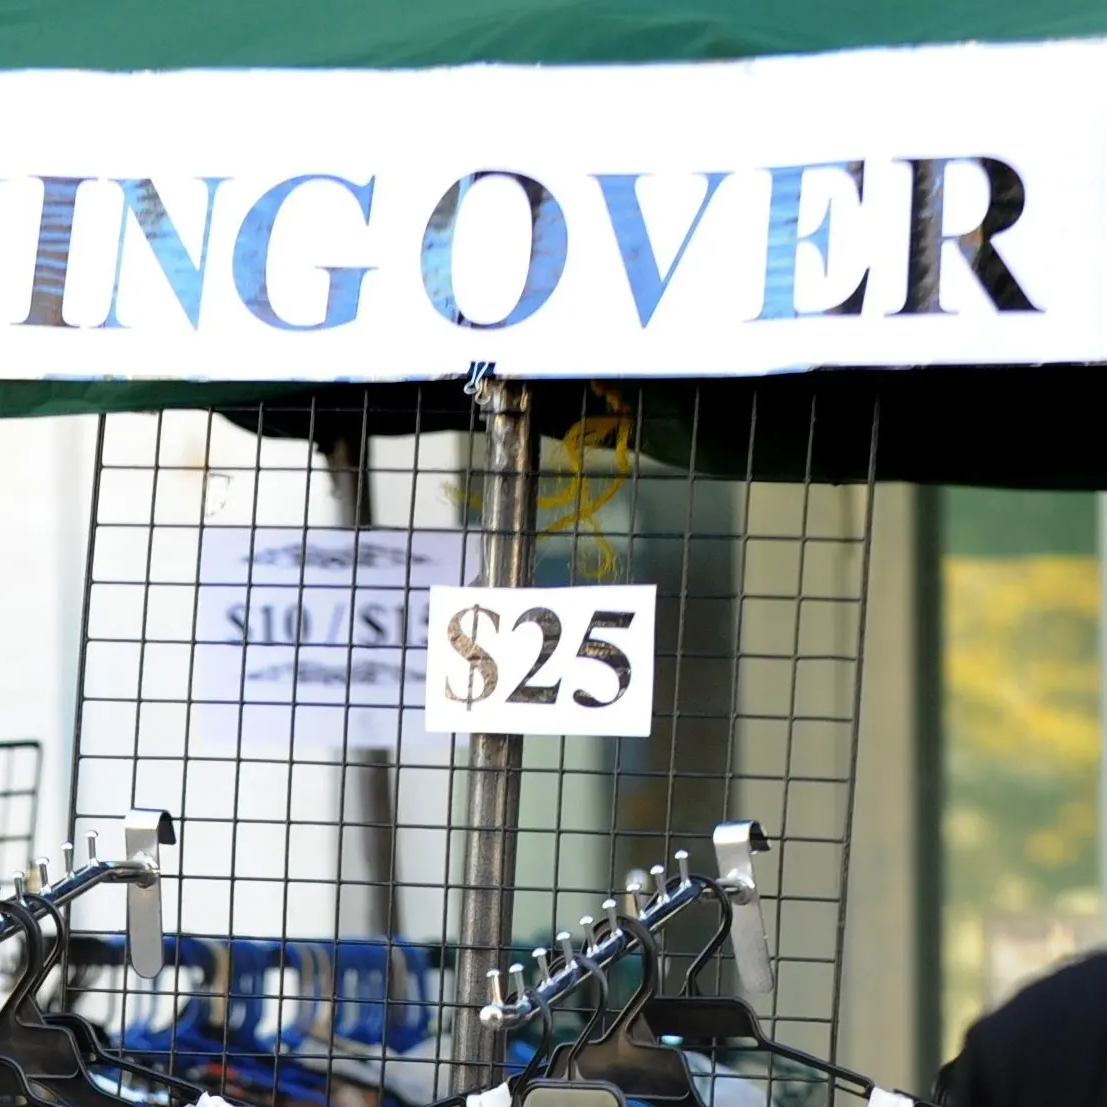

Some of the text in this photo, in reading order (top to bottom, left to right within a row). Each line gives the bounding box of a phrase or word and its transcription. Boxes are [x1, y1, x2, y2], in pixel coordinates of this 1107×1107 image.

[421, 155, 1044, 330] OVER
[225, 601, 312, 645] $10
[445, 602, 636, 711] $25
